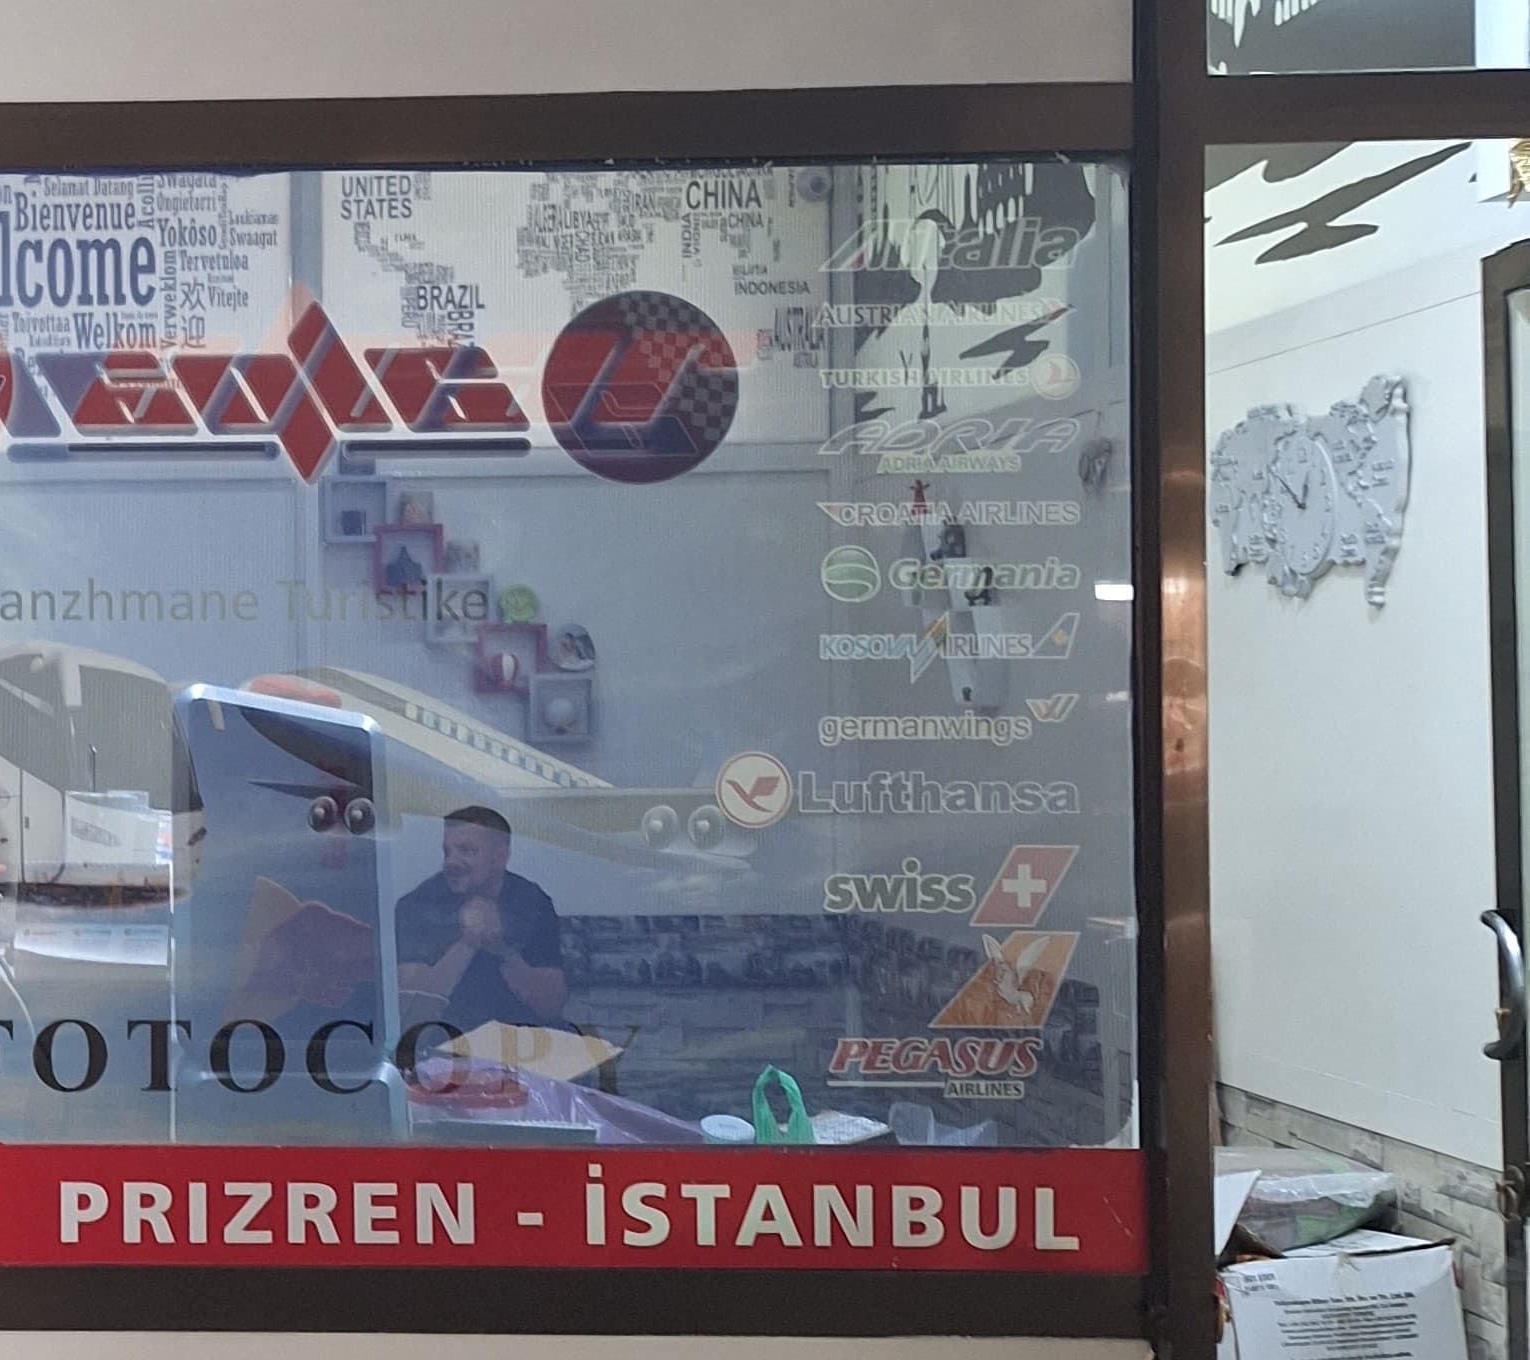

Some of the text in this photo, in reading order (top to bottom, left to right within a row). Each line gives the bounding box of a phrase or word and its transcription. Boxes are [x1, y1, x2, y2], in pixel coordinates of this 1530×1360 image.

[44, 177, 135, 200] Selamat Datang
[341, 175, 412, 197] UNITED
[686, 179, 762, 210] CHINA
[14, 191, 136, 232] Bienvenue
[340, 197, 413, 220] STATES
[728, 212, 764, 228] CHINA
[158, 217, 217, 247] Yokôso
[681, 212, 693, 259] INDIA
[416, 285, 485, 311] BRAZIL
[734, 280, 811, 296] INDONESIA
[73, 311, 157, 350] Welkom
[821, 368, 918, 388] TURKISH
[839, 501, 1080, 526] CROATIA AIRLINES
[888, 557, 1081, 590] Germania
[284, 577, 490, 623] Turistike
[819, 710, 1031, 746] germanwings
[798, 771, 1081, 814] Lufthansa
[824, 857, 976, 913] swiss
[829, 1037, 1044, 1078] PEGASUS
[945, 1080, 1024, 1098] AIRLINES
[59, 1180, 476, 1246] PRIZREN
[586, 1163, 1081, 1253] İSTANBUL
